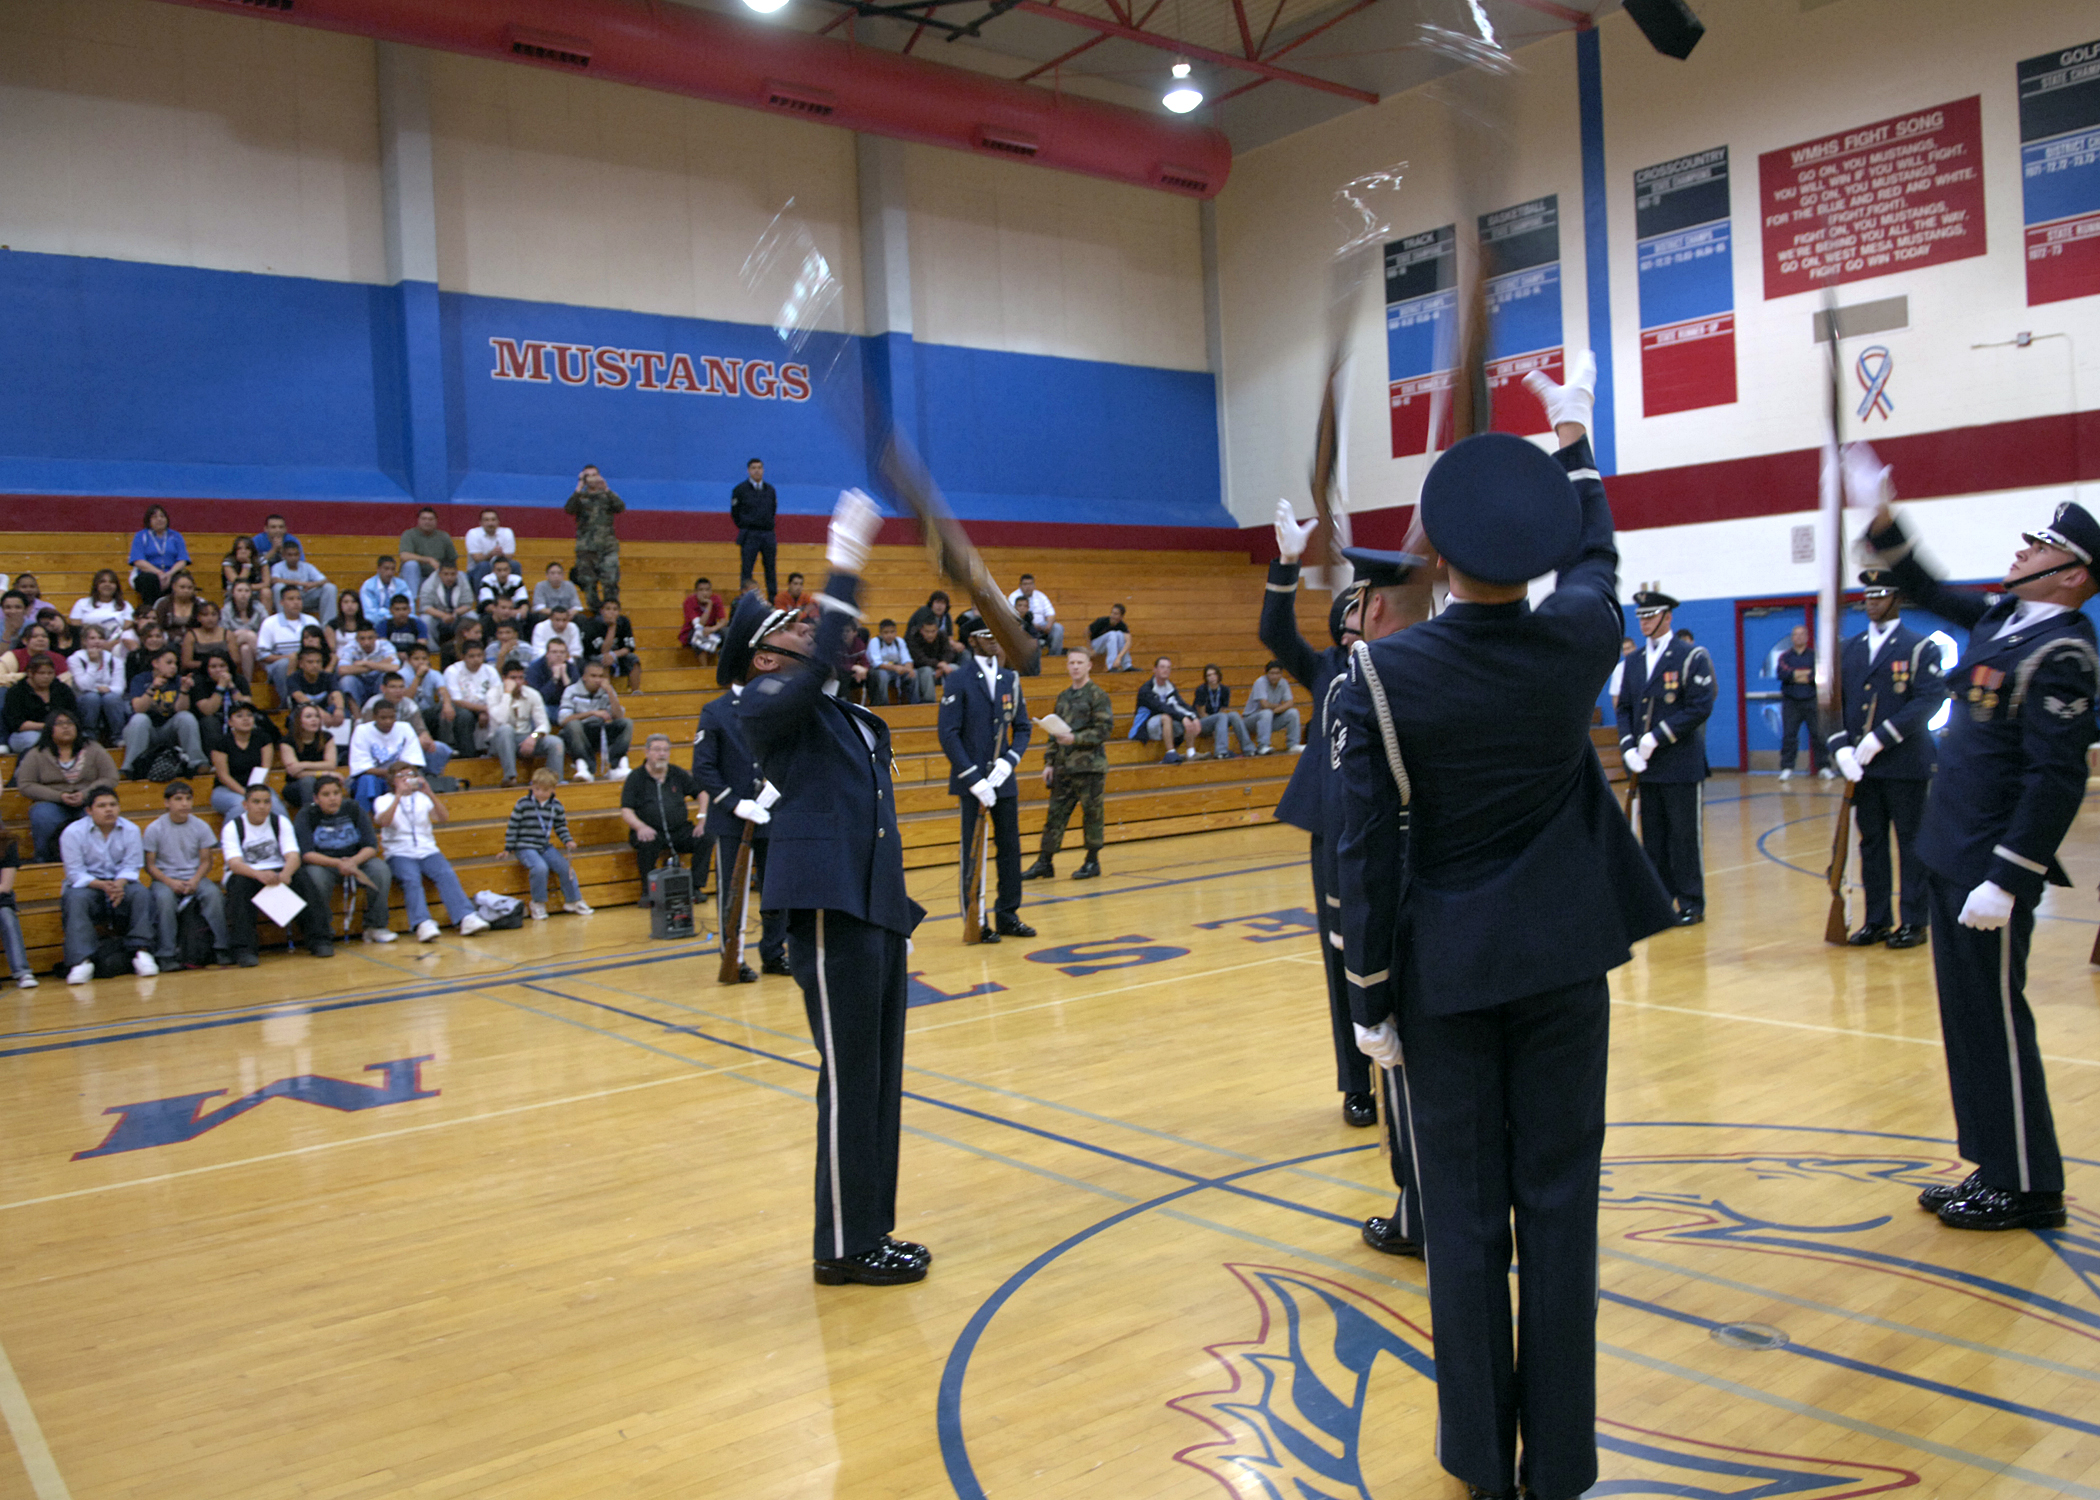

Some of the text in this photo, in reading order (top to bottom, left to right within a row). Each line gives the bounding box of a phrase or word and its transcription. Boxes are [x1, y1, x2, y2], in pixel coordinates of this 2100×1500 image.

[2060, 43, 2100, 66] GOLF
[1792, 110, 1943, 164] WMHS FIGHT SONG
[1774, 187, 1795, 201] YOU
[1799, 180, 1824, 194] WILL
[1829, 173, 1850, 187] WIN
[1855, 169, 1865, 180] IF
[1869, 162, 1892, 177] YOU
[1896, 154, 1923, 169] WILL
[1798, 170, 1815, 183] GO
[1843, 156, 1865, 171] YOU
[1800, 194, 1816, 206] GO
[1845, 181, 1867, 195] YOU
[1872, 164, 1935, 188] MUSTANGS
[1766, 213, 1788, 227] FOR
[1793, 207, 1812, 220] THE
[1817, 199, 1844, 214] BLUE
[1849, 192, 1873, 206] AND
[1877, 185, 1901, 199] RED
[1905, 178, 1930, 193] AND
[1403, 233, 1435, 249] TRACK
[1794, 230, 1824, 245] FIGHT
[1853, 217, 1876, 232] YOU
[1815, 235, 1856, 252] BEHIND
[1861, 228, 1884, 242] YOU
[1888, 223, 1908, 236] ALL
[1913, 216, 1936, 230] THE
[1781, 260, 1798, 273] GO
[1825, 247, 1856, 263] WEST
[1860, 239, 1892, 255] MESA
[1809, 244, 1930, 279] FIGHT GO WIN TODAY
[490, 337, 812, 403] MUSTANGS
